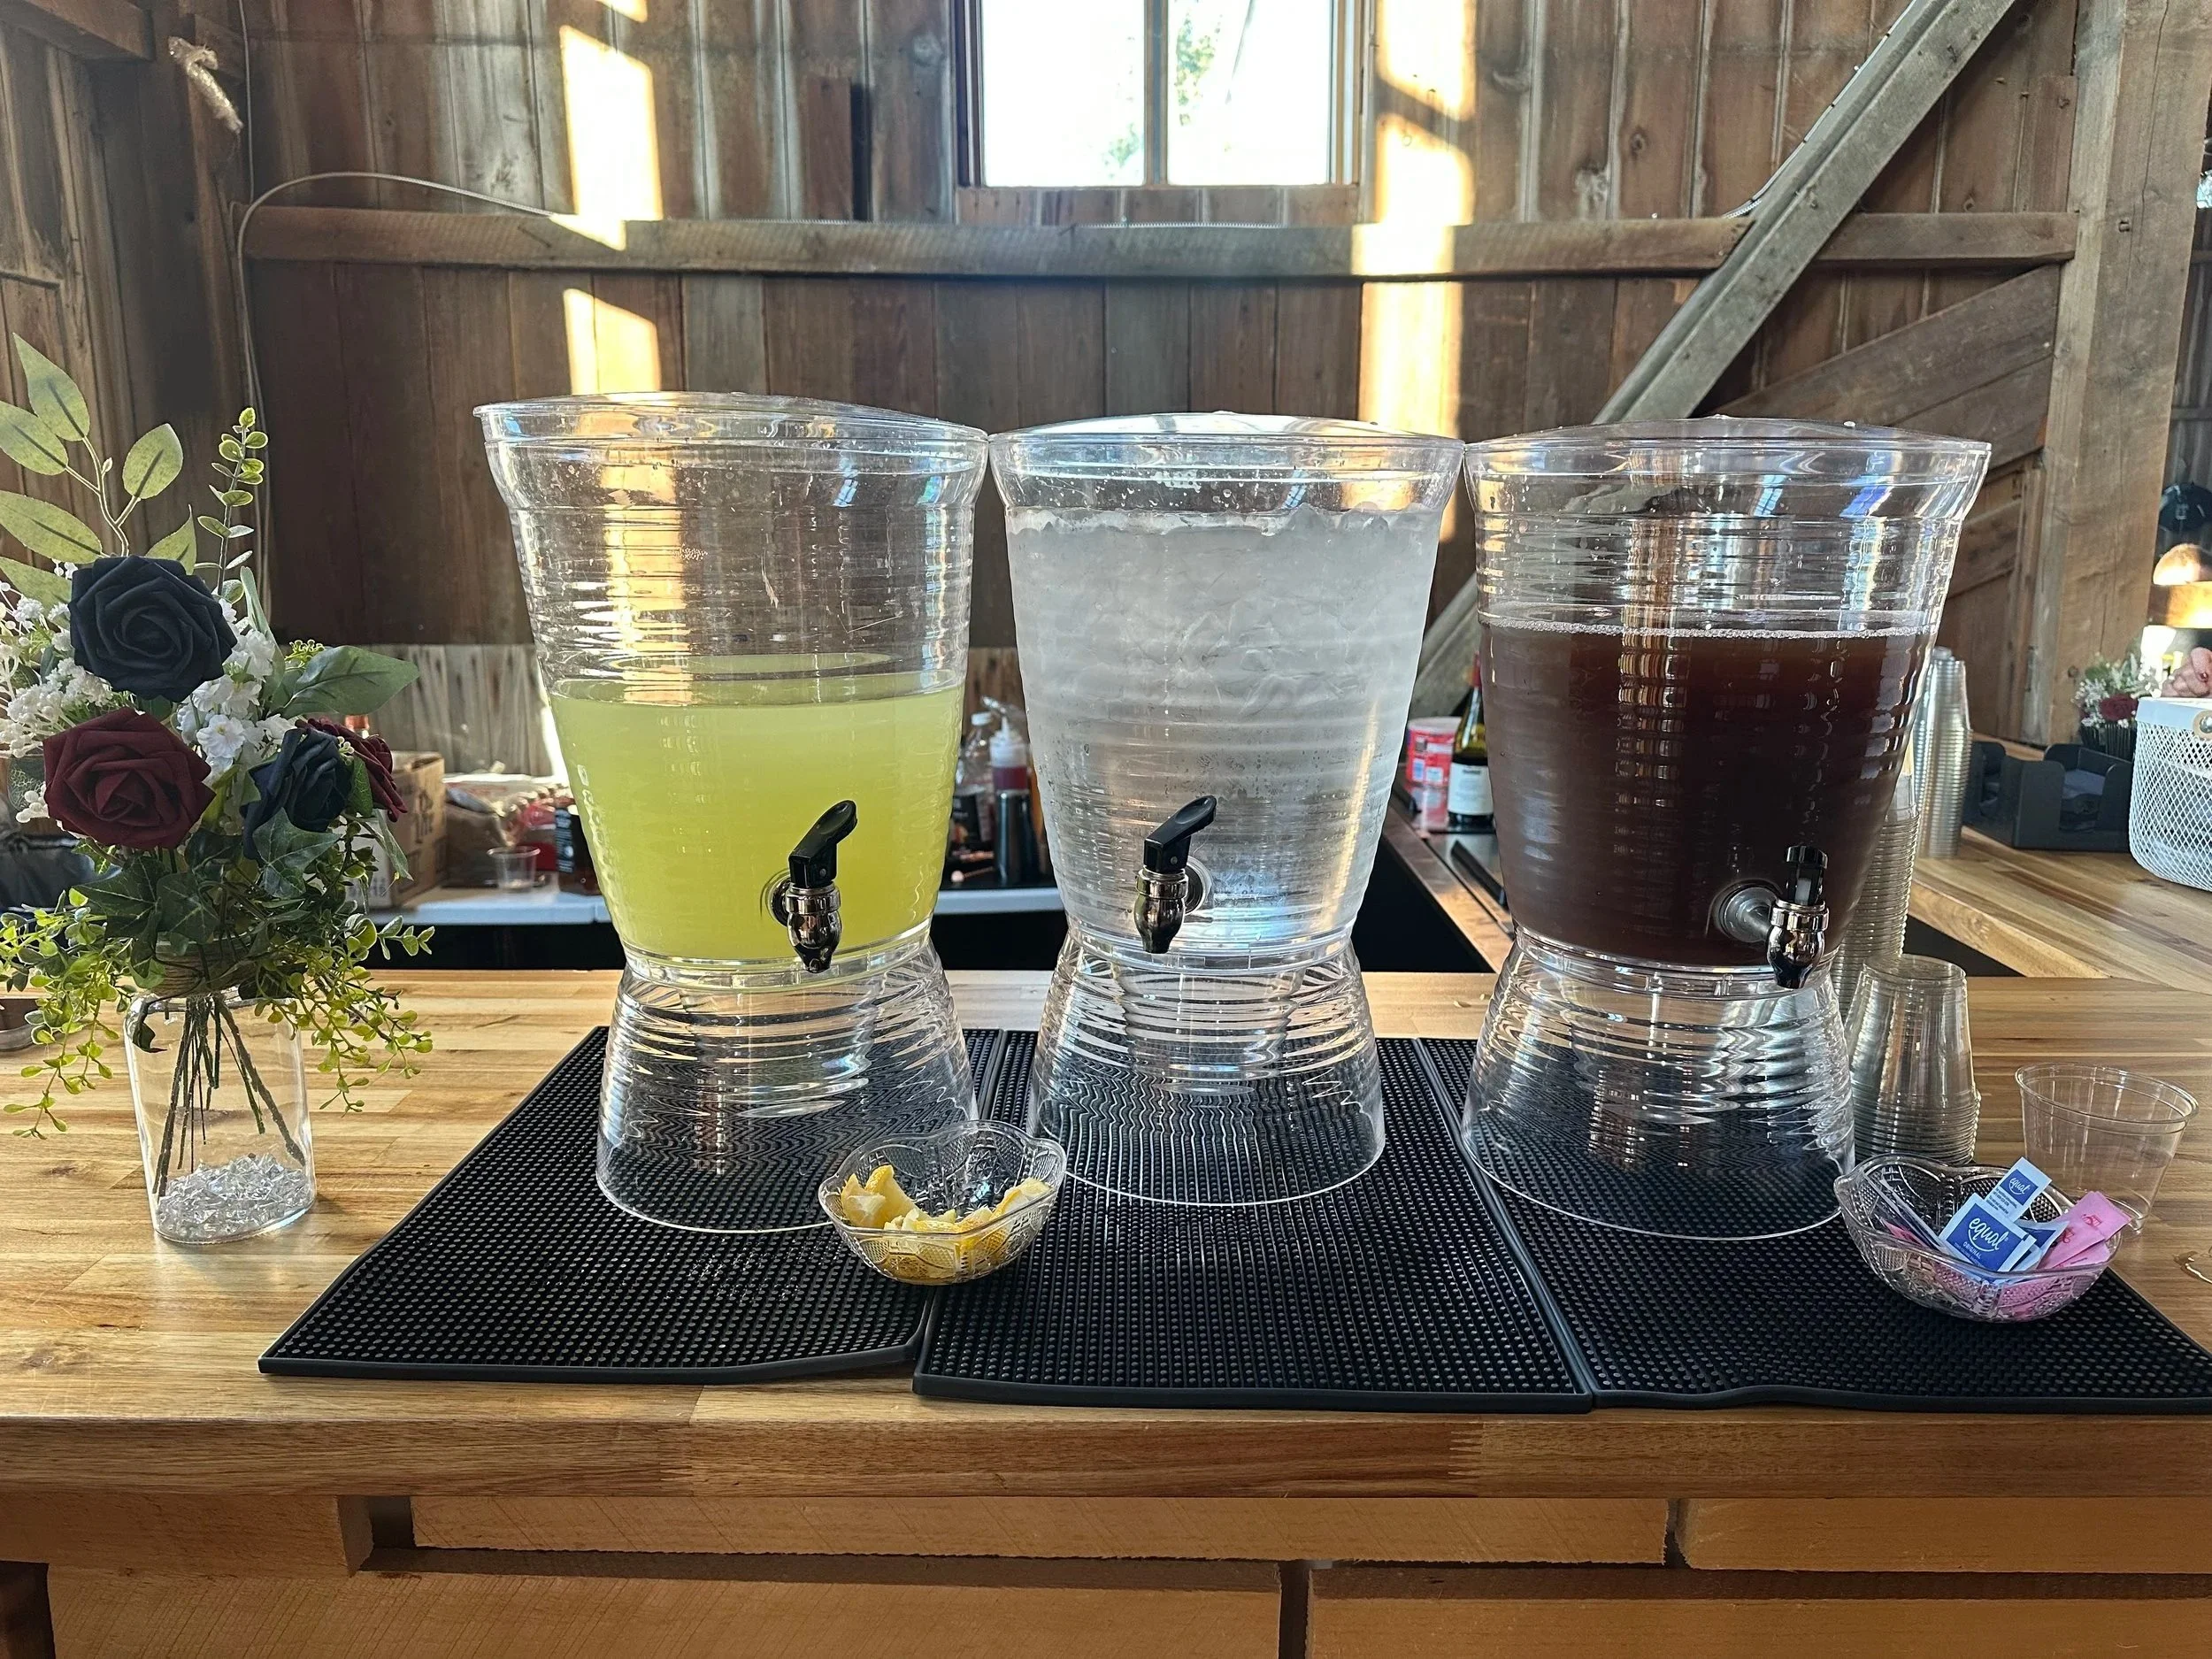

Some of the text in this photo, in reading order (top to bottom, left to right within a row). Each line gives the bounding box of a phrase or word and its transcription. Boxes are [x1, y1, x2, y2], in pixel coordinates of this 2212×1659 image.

[2009, 1178, 2031, 1194] equal
[1969, 1217, 2009, 1250] equal
[1962, 1241, 1982, 1259] ORIGINAL
